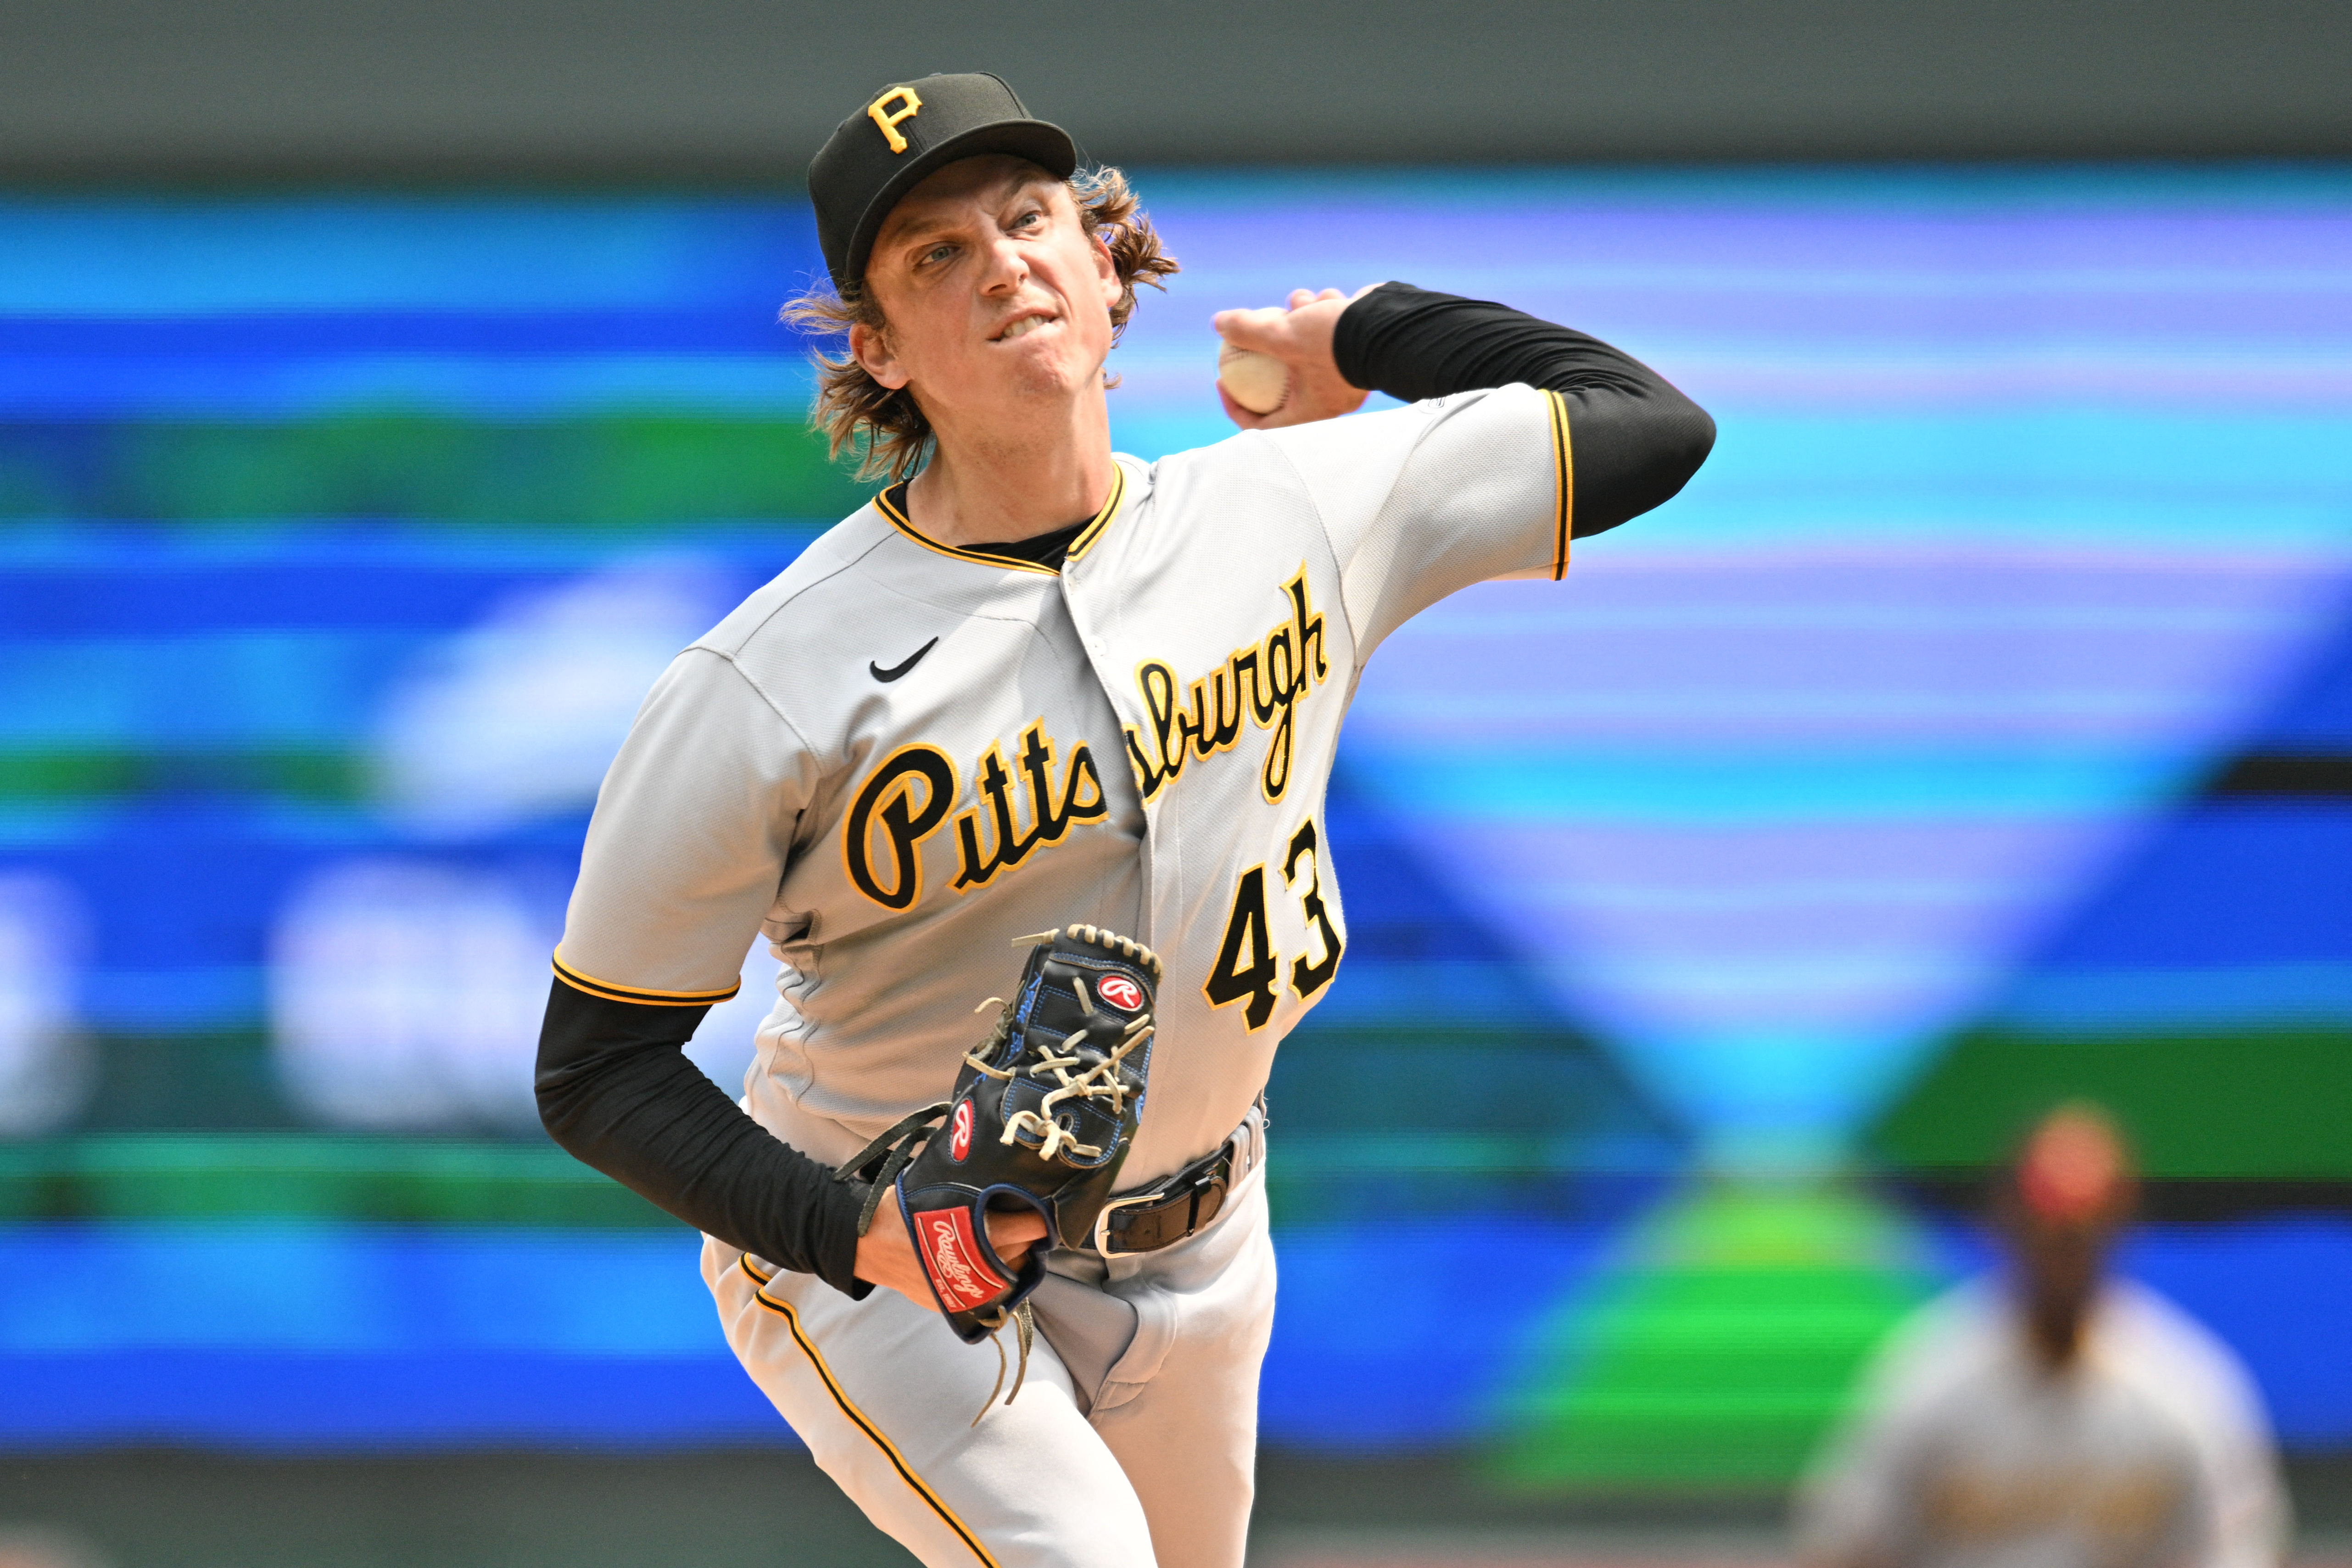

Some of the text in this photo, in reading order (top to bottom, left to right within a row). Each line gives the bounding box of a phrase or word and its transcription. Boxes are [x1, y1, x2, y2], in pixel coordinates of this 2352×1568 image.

[868, 87, 922, 154] P
[843, 560, 1328, 913] Pittsburgh
[1201, 815, 1344, 1036] 43
[1101, 980, 1137, 1007] R
[933, 1221, 984, 1298] Rawlings
